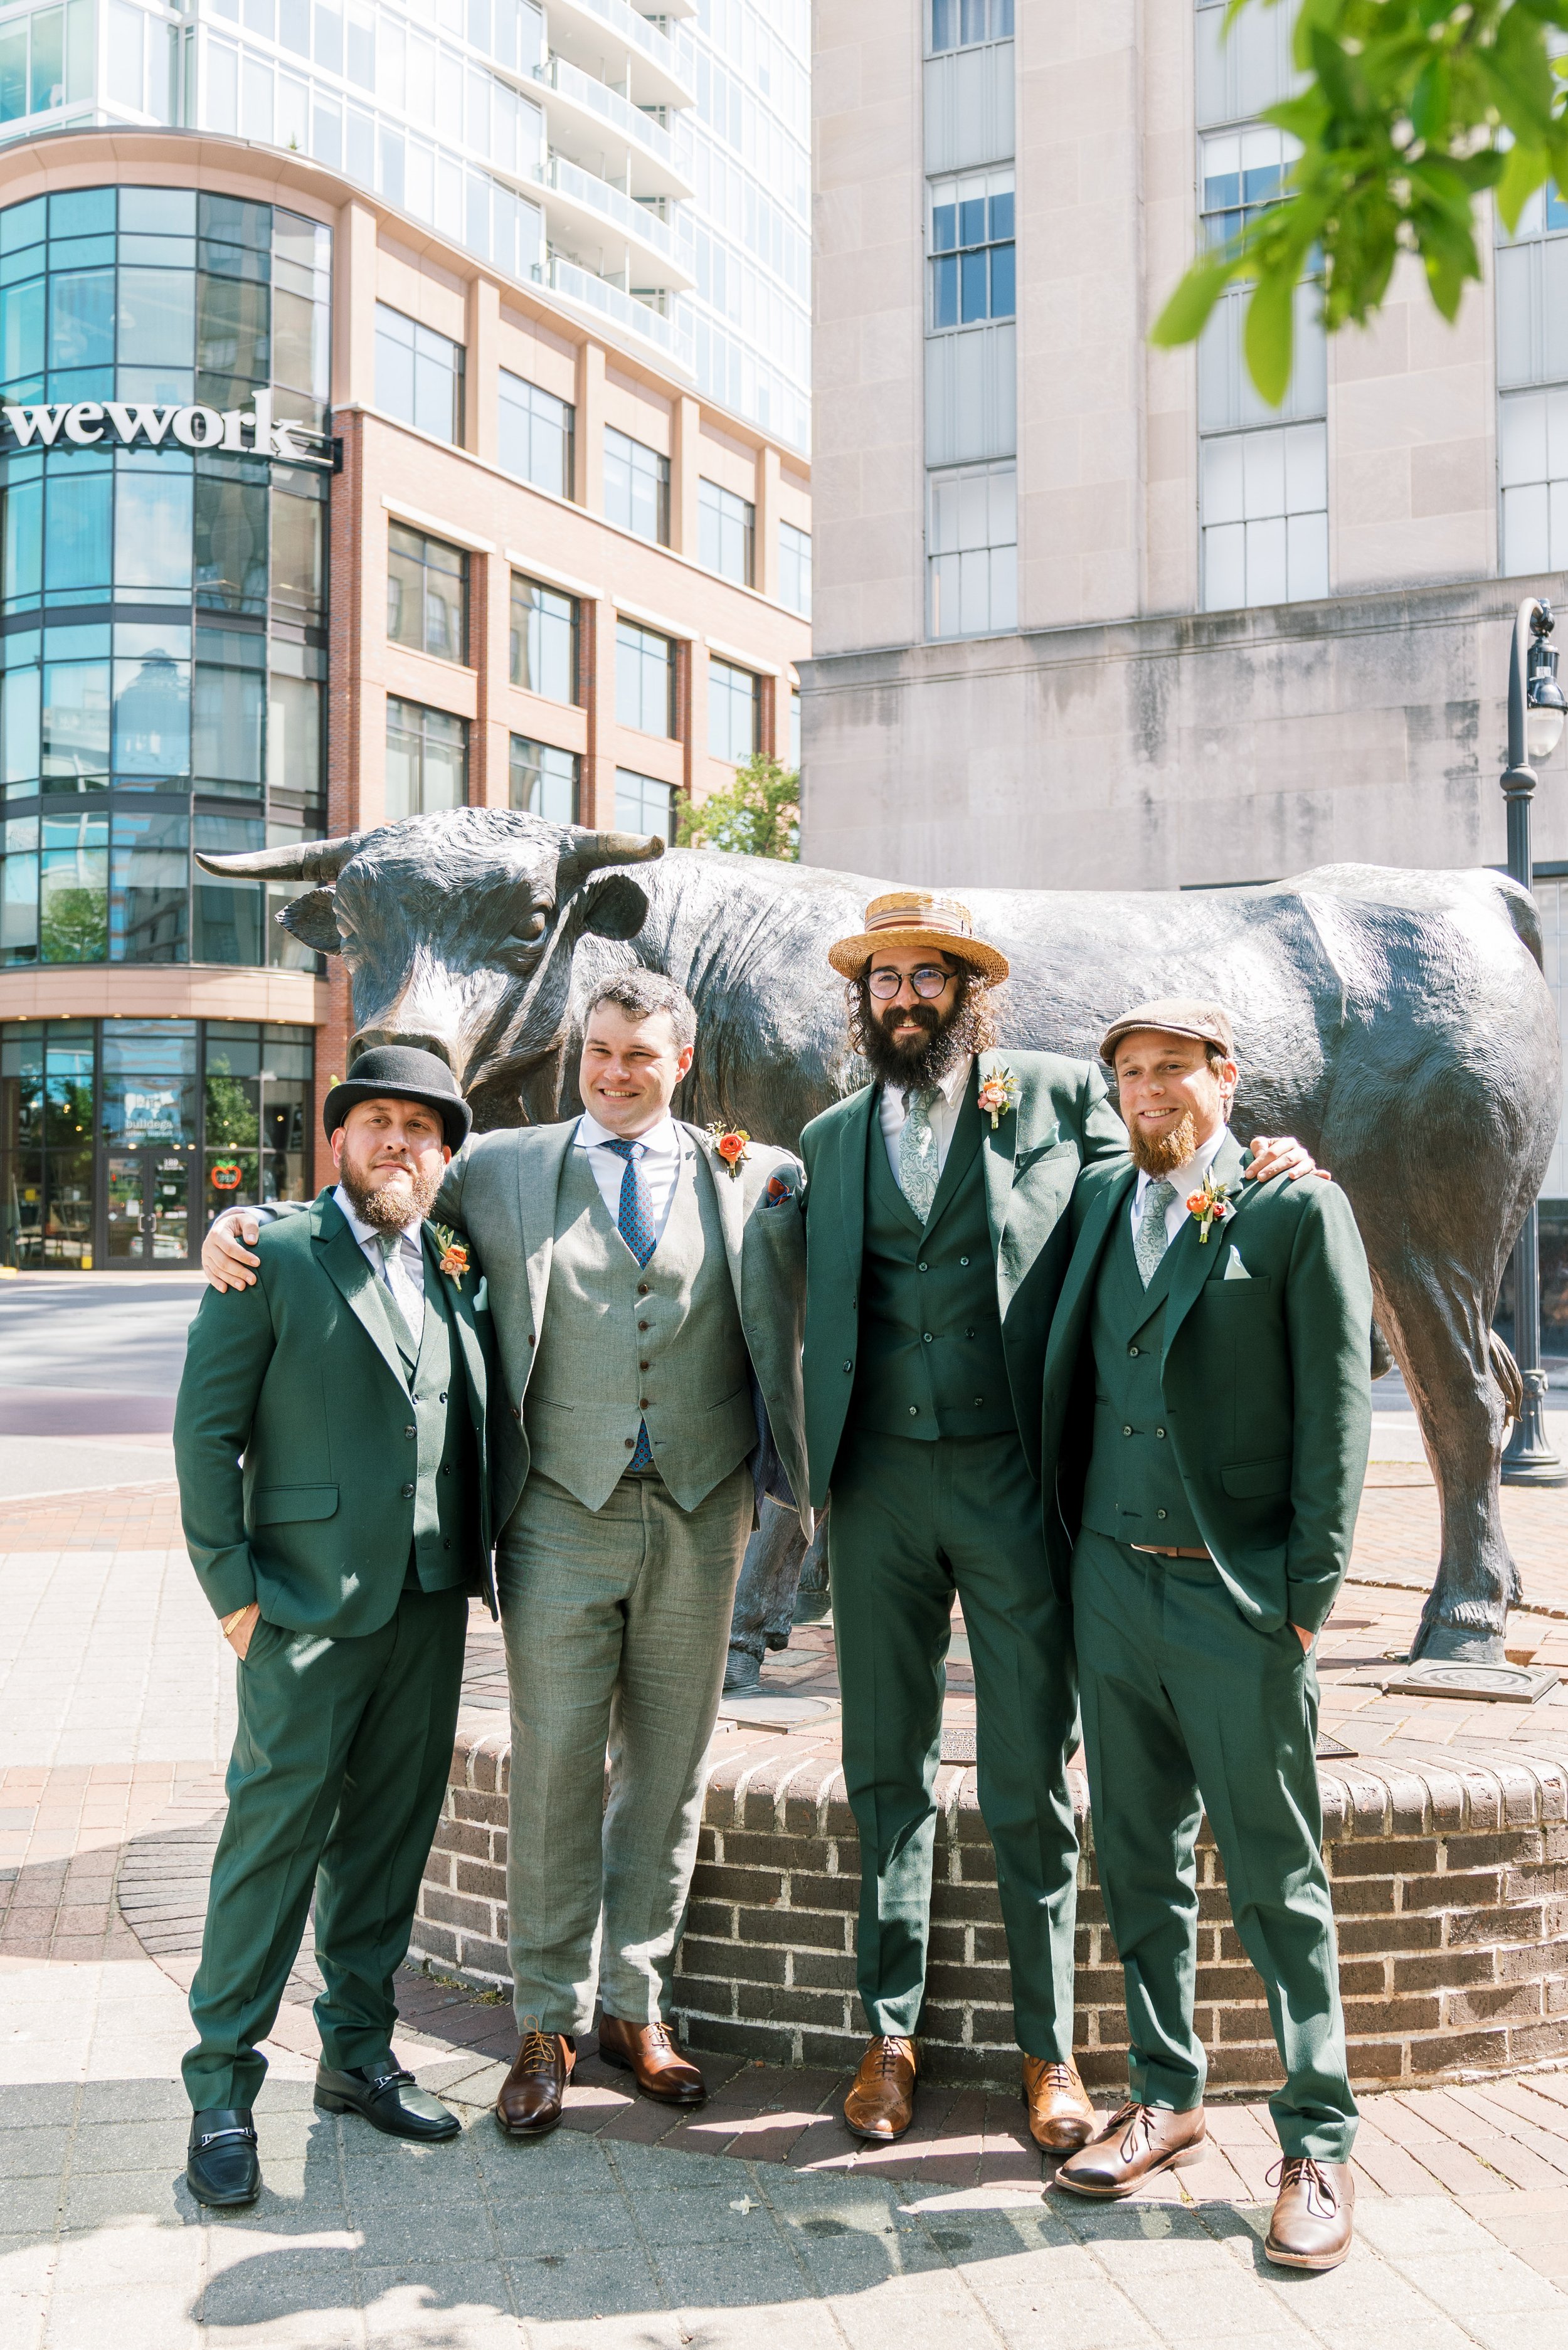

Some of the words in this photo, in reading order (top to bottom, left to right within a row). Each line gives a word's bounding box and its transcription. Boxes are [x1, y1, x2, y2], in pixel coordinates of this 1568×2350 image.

[1, 388, 306, 460] wework
[125, 1118, 174, 1131] bulldega
[216, 1173, 236, 1183] OPEN
